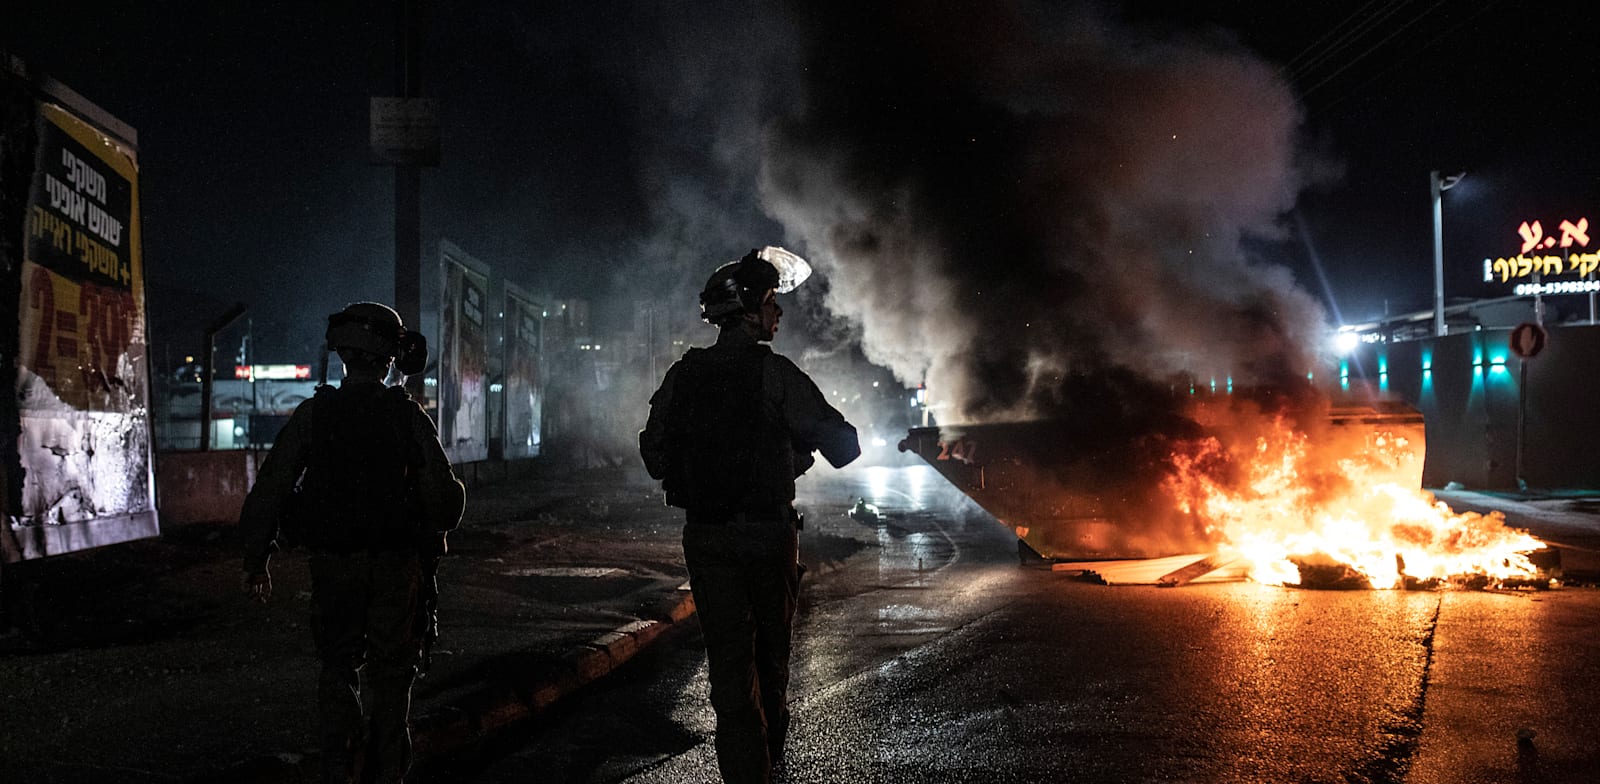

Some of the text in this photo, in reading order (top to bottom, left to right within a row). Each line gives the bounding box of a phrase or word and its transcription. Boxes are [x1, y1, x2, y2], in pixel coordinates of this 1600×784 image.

[62, 147, 106, 205] משקפי
[31, 205, 72, 255] ראייה
[46, 173, 122, 247] שמש אופטי
[75, 230, 119, 281] משקפי
[1493, 253, 1563, 283] חילוף
[1569, 249, 1600, 279] קי
[937, 438, 977, 464] 247
